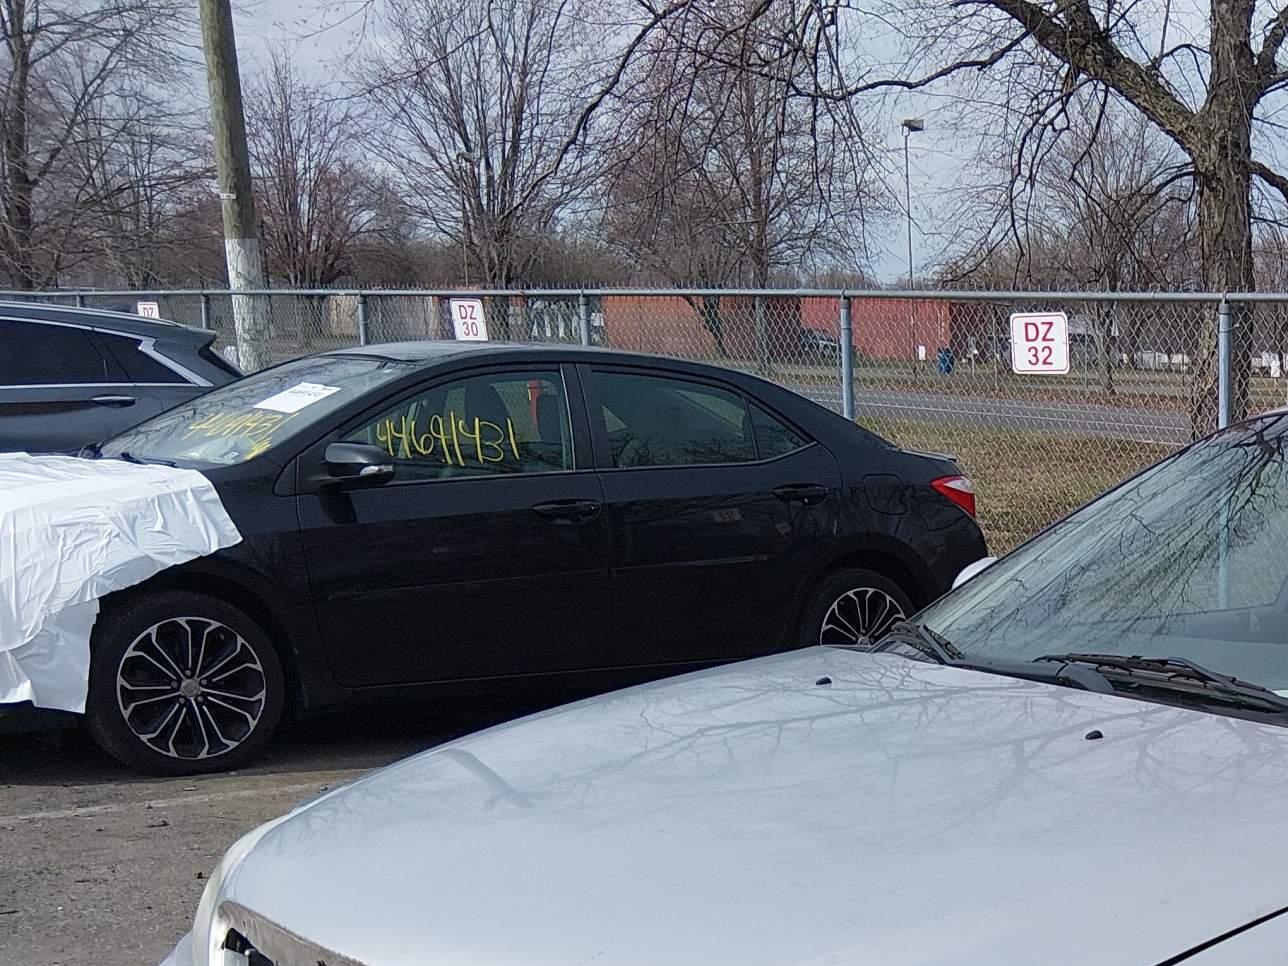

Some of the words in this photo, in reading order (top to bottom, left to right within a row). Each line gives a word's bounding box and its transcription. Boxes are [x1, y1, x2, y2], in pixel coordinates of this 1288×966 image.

[458, 304, 477, 320] DZ
[463, 321, 479, 337] 30
[1024, 322, 1055, 342] DZ
[1027, 346, 1053, 366] 32
[376, 410, 520, 467] 44691431
